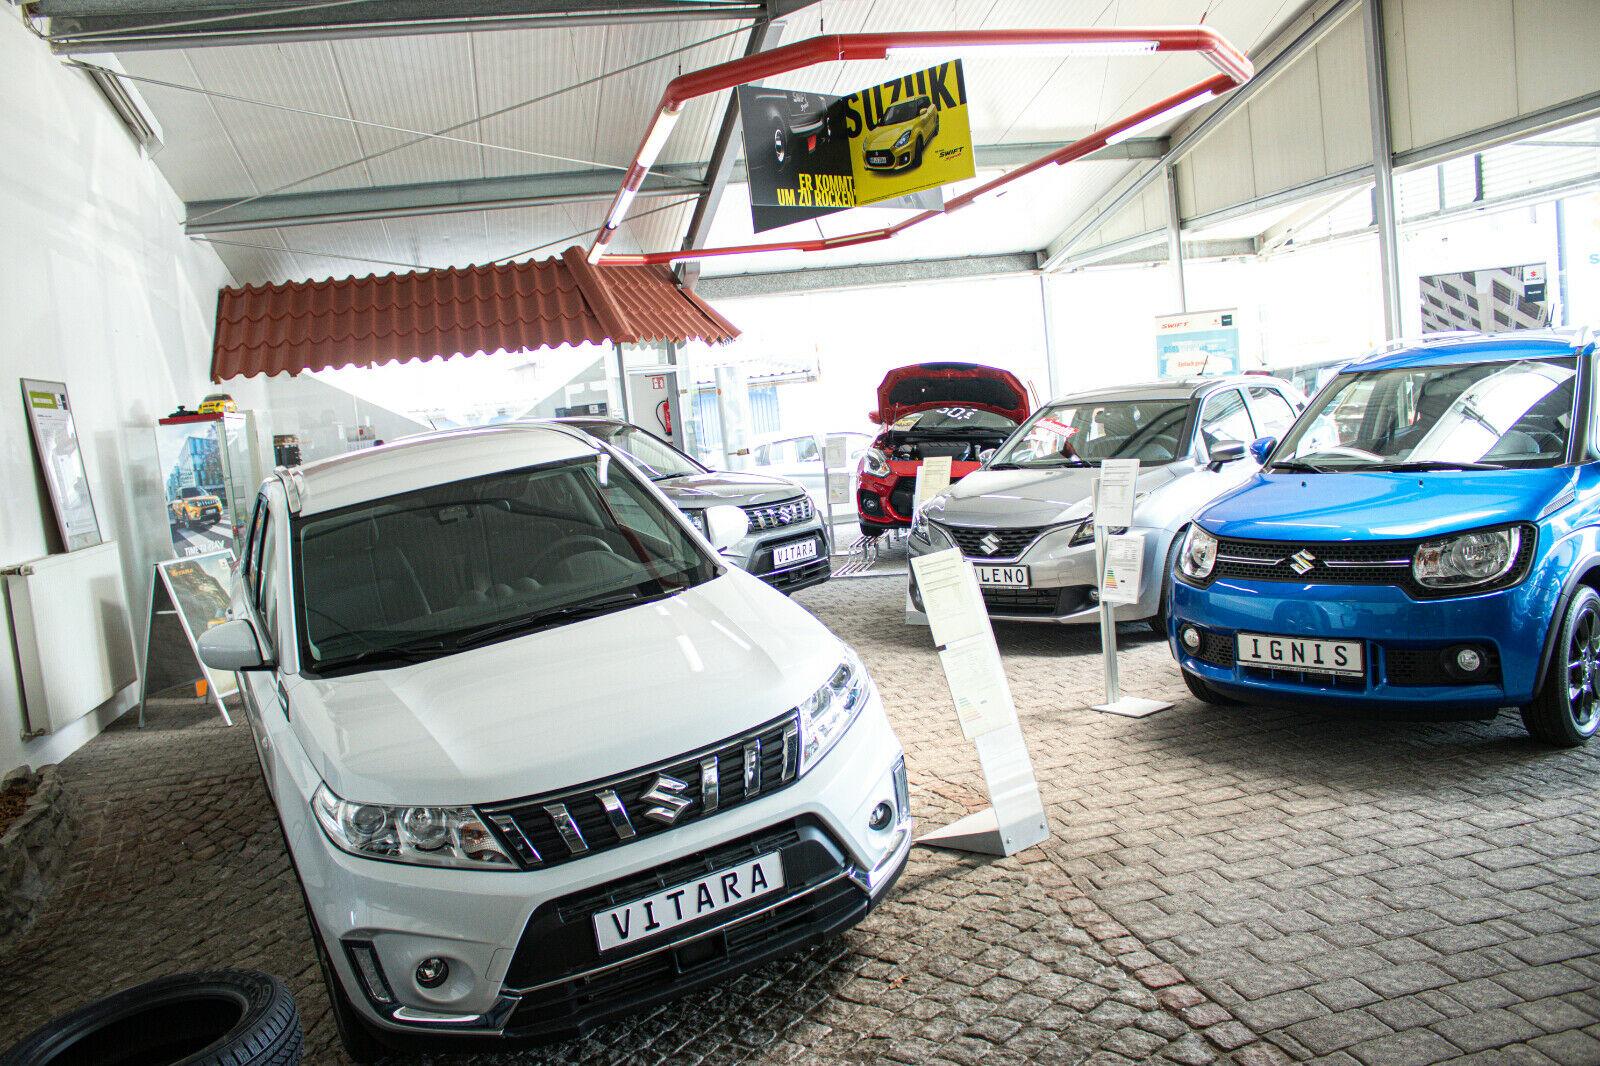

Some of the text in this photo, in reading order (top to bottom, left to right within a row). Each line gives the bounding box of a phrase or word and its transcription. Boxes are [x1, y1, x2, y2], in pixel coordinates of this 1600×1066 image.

[939, 146, 964, 158] SWIFT
[798, 173, 813, 191] ER
[777, 188, 796, 207] UM
[798, 189, 812, 207] ZU
[1161, 321, 1190, 329] SWIFT
[777, 542, 814, 563] VITARA
[974, 567, 1024, 583] LENO
[1252, 638, 1348, 667] IGNIS
[611, 862, 769, 940] VITARA
